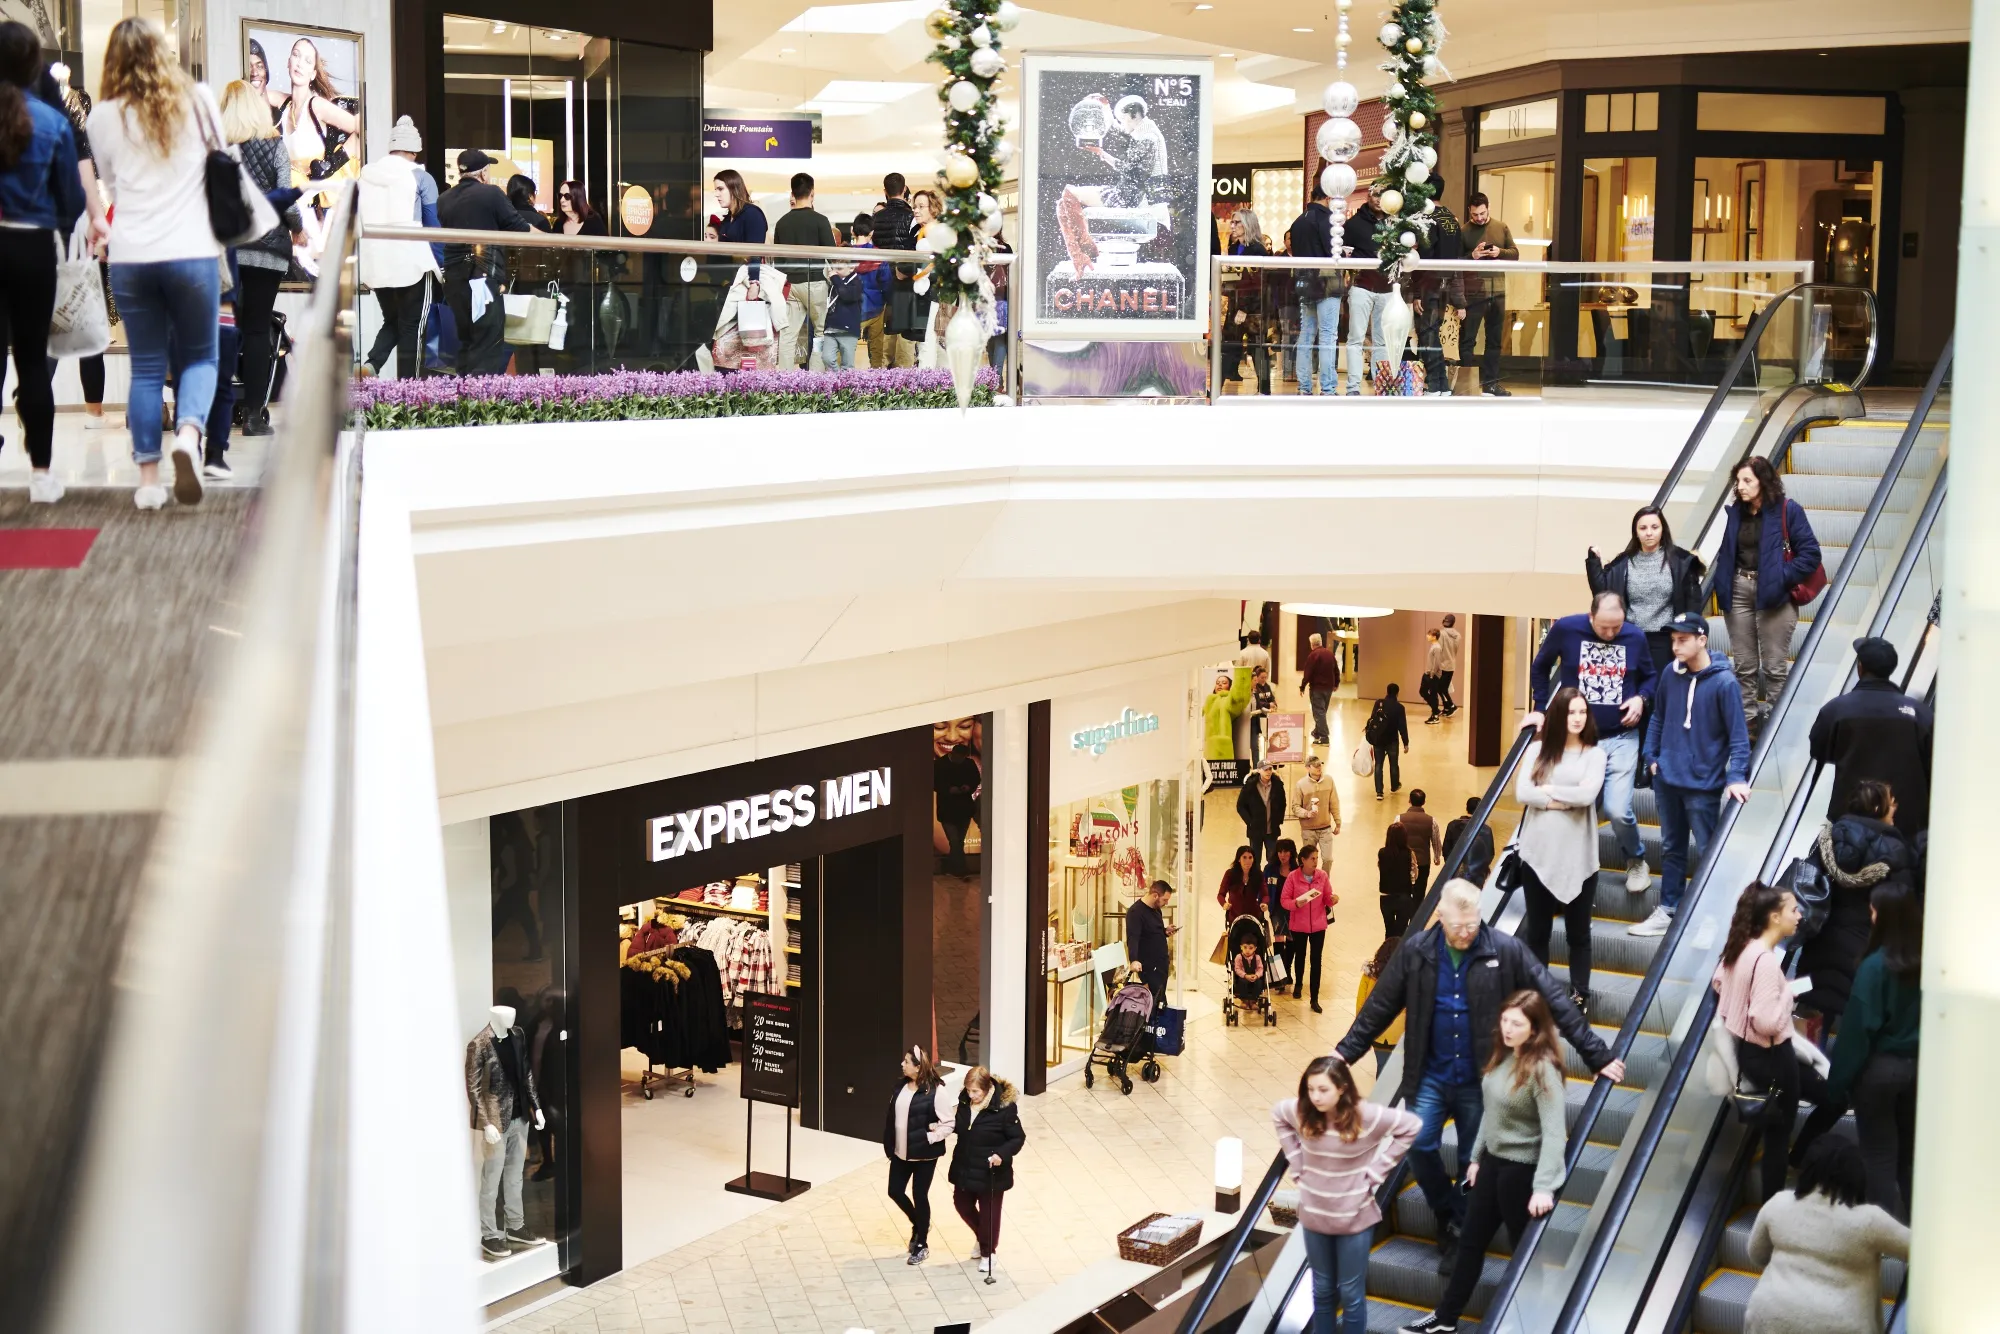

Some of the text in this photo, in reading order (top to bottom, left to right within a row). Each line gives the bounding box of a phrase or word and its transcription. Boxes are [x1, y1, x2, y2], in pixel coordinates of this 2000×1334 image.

[1158, 98, 1187, 107] L'EAU
[703, 124, 774, 134] Drinking Fountain
[627, 207, 651, 217] BRIGHT
[626, 216, 650, 225] FRIDAY
[1054, 287, 1177, 312] CHANEL
[1073, 707, 1159, 755] sugarfina
[646, 766, 891, 862] EXPRESS MEN
[1083, 820, 1139, 850] SEASON'S
[754, 1014, 765, 1027] $20
[753, 1029, 764, 1041] $30
[752, 1043, 764, 1056] $50
